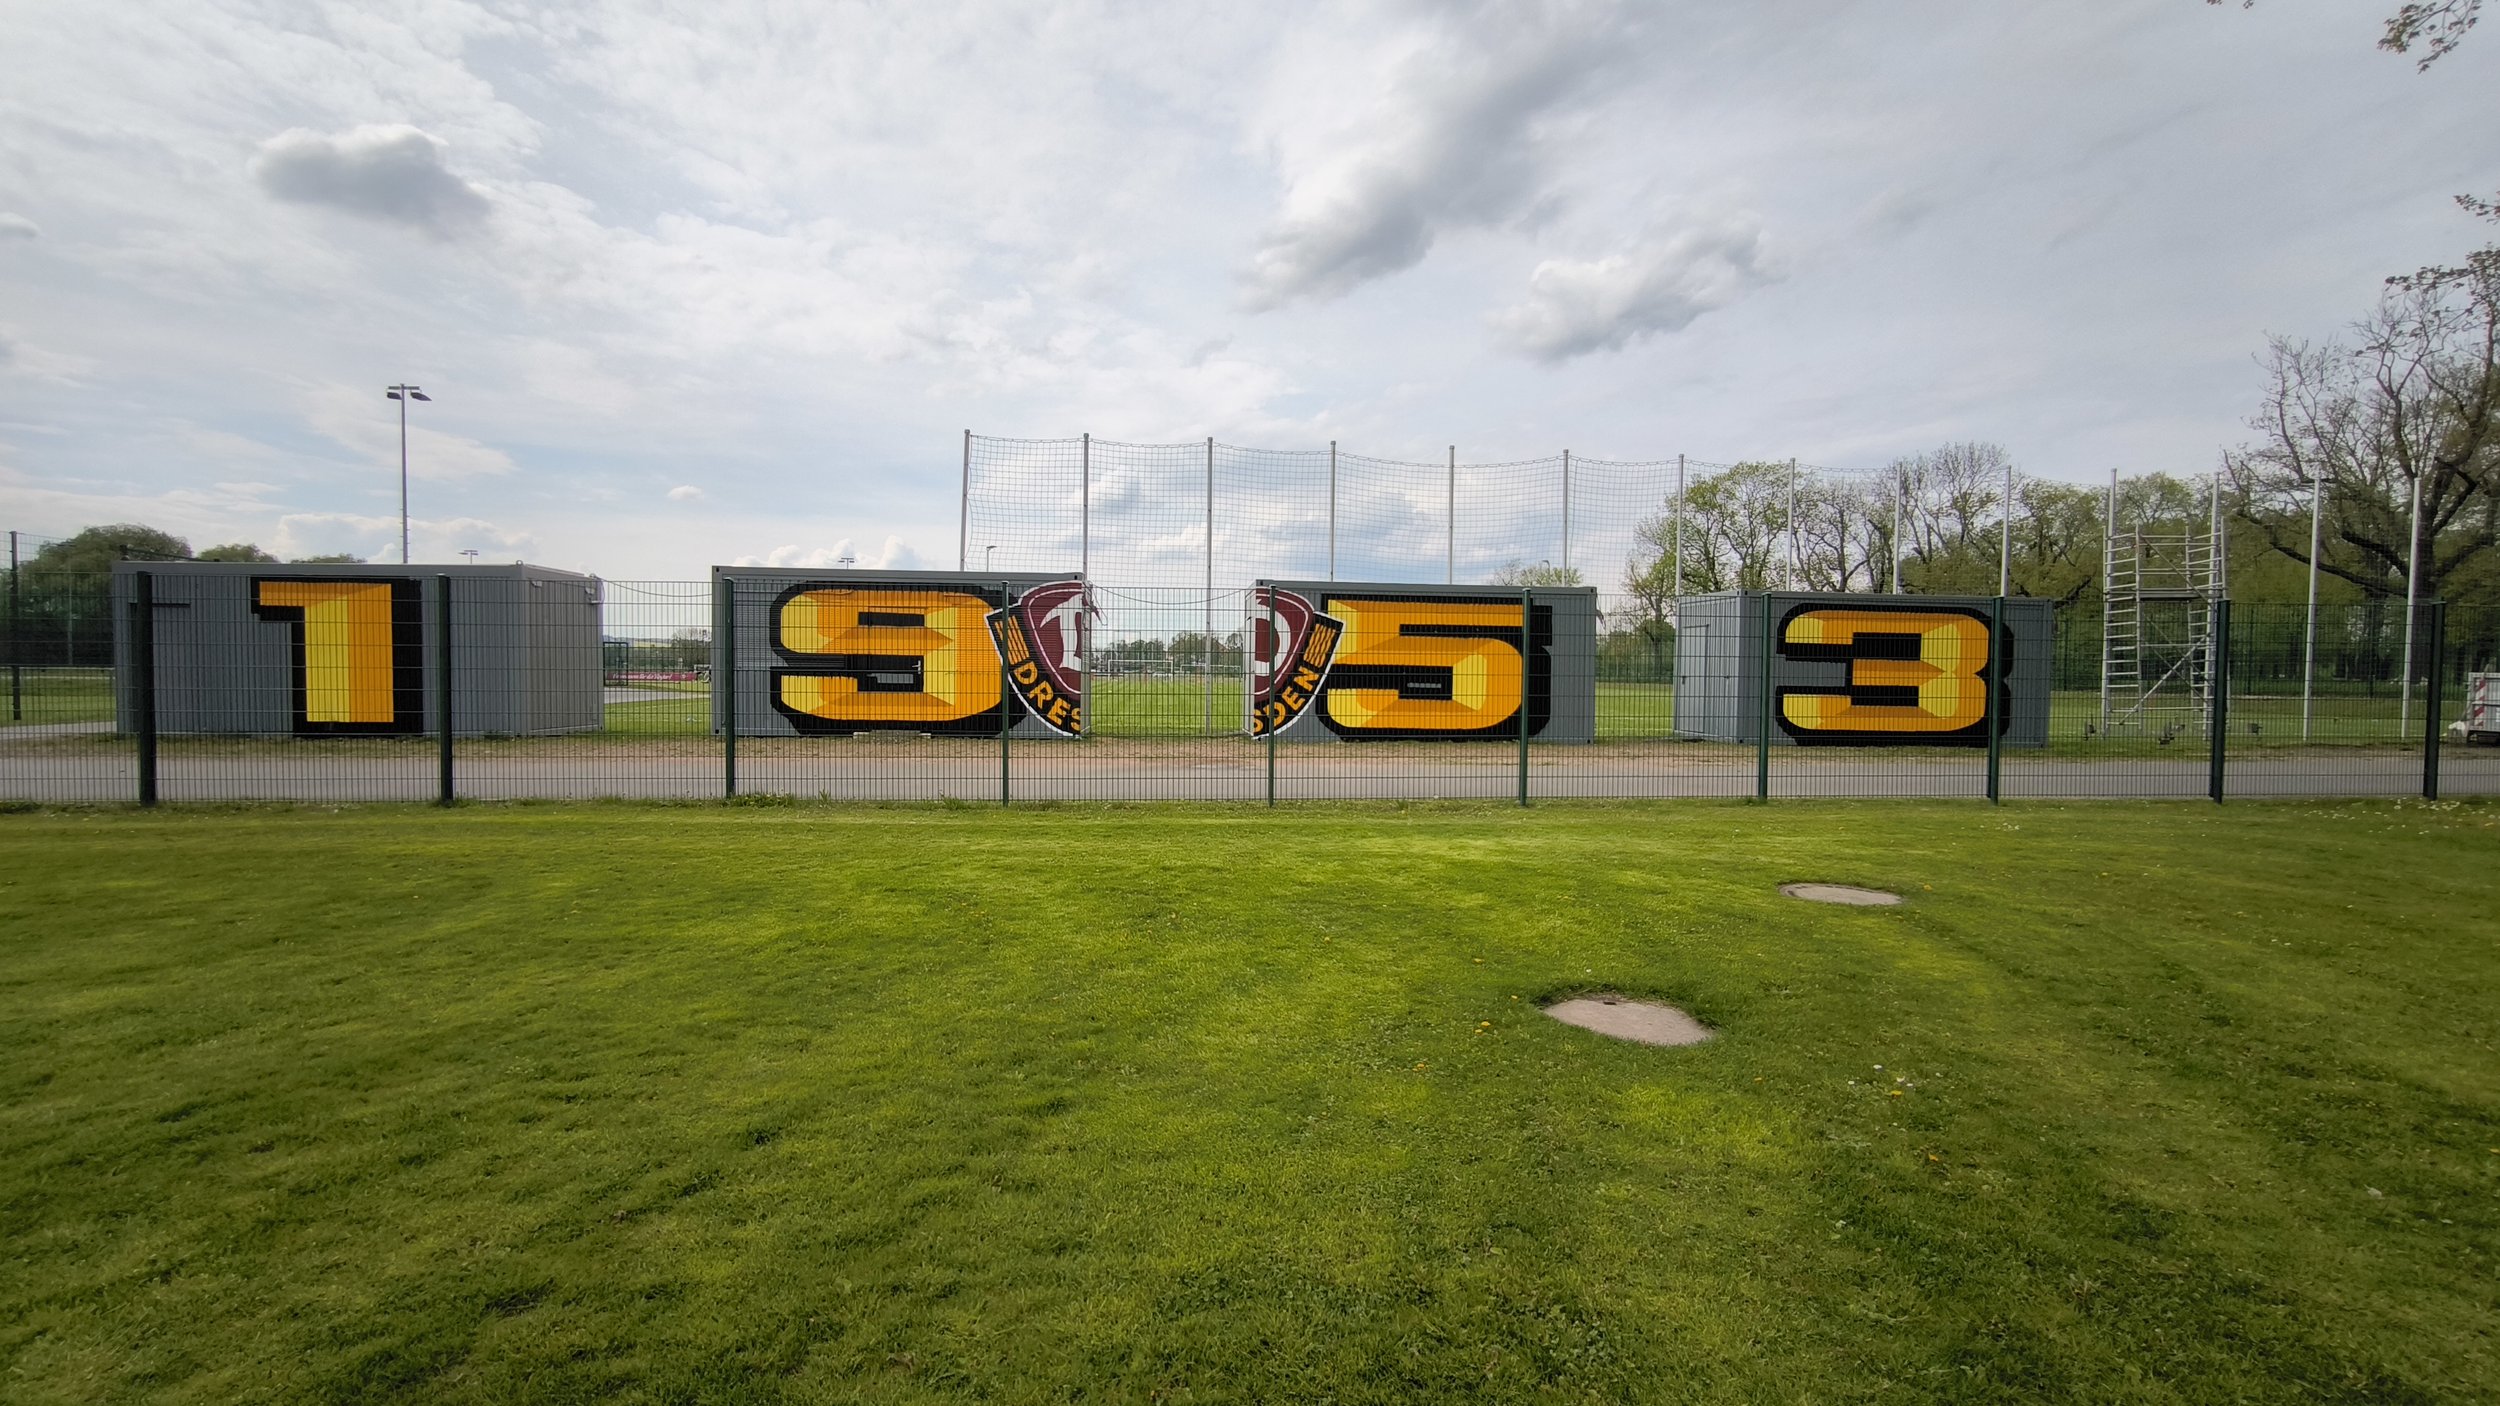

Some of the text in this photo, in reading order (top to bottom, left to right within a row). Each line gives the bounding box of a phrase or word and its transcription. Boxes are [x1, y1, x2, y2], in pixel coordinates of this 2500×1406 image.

[254, 578, 405, 732] 1
[772, 582, 1016, 732] 9
[1319, 595, 1540, 736] 5
[1778, 605, 2003, 741] 3
